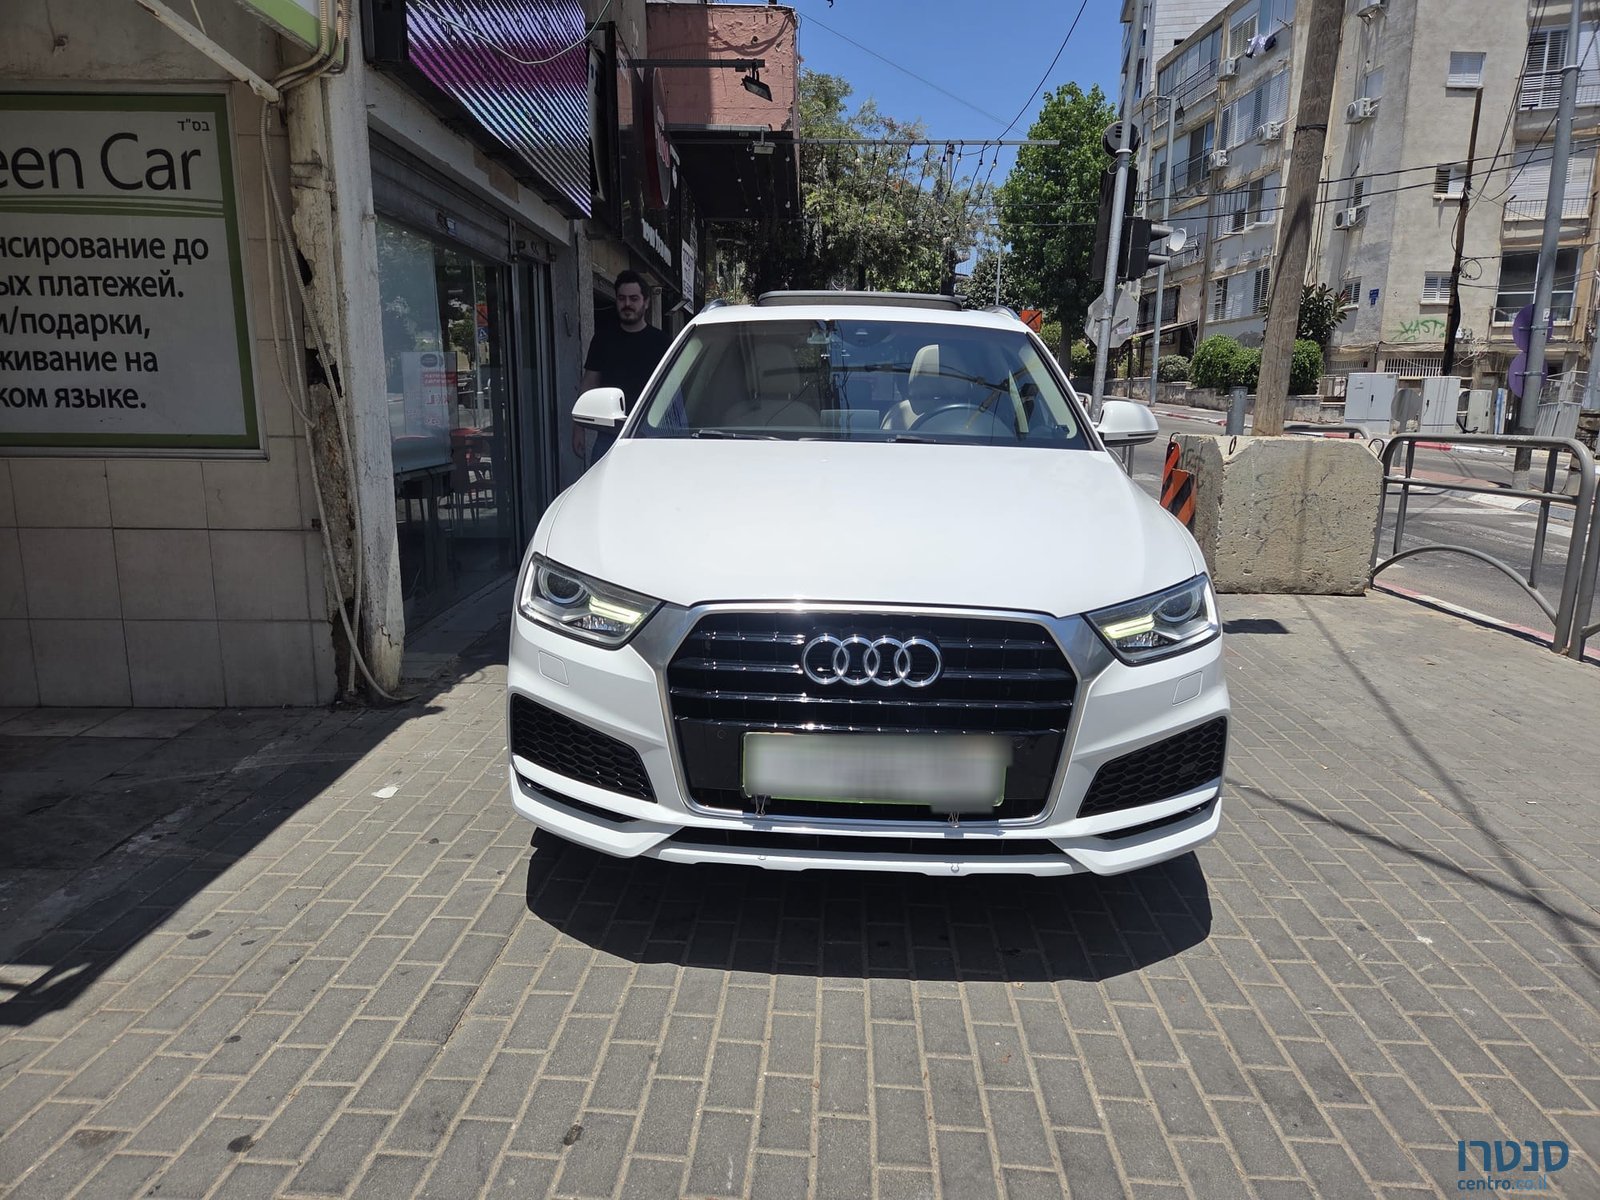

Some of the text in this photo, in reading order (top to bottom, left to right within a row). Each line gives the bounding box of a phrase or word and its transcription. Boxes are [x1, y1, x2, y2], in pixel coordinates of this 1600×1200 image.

[177, 118, 210, 131] בס"ד
[0, 132, 202, 191] en Car
[172, 238, 209, 266] до
[38, 269, 185, 298] платежей.
[124, 351, 159, 373] на
[54, 387, 147, 410] языке.
